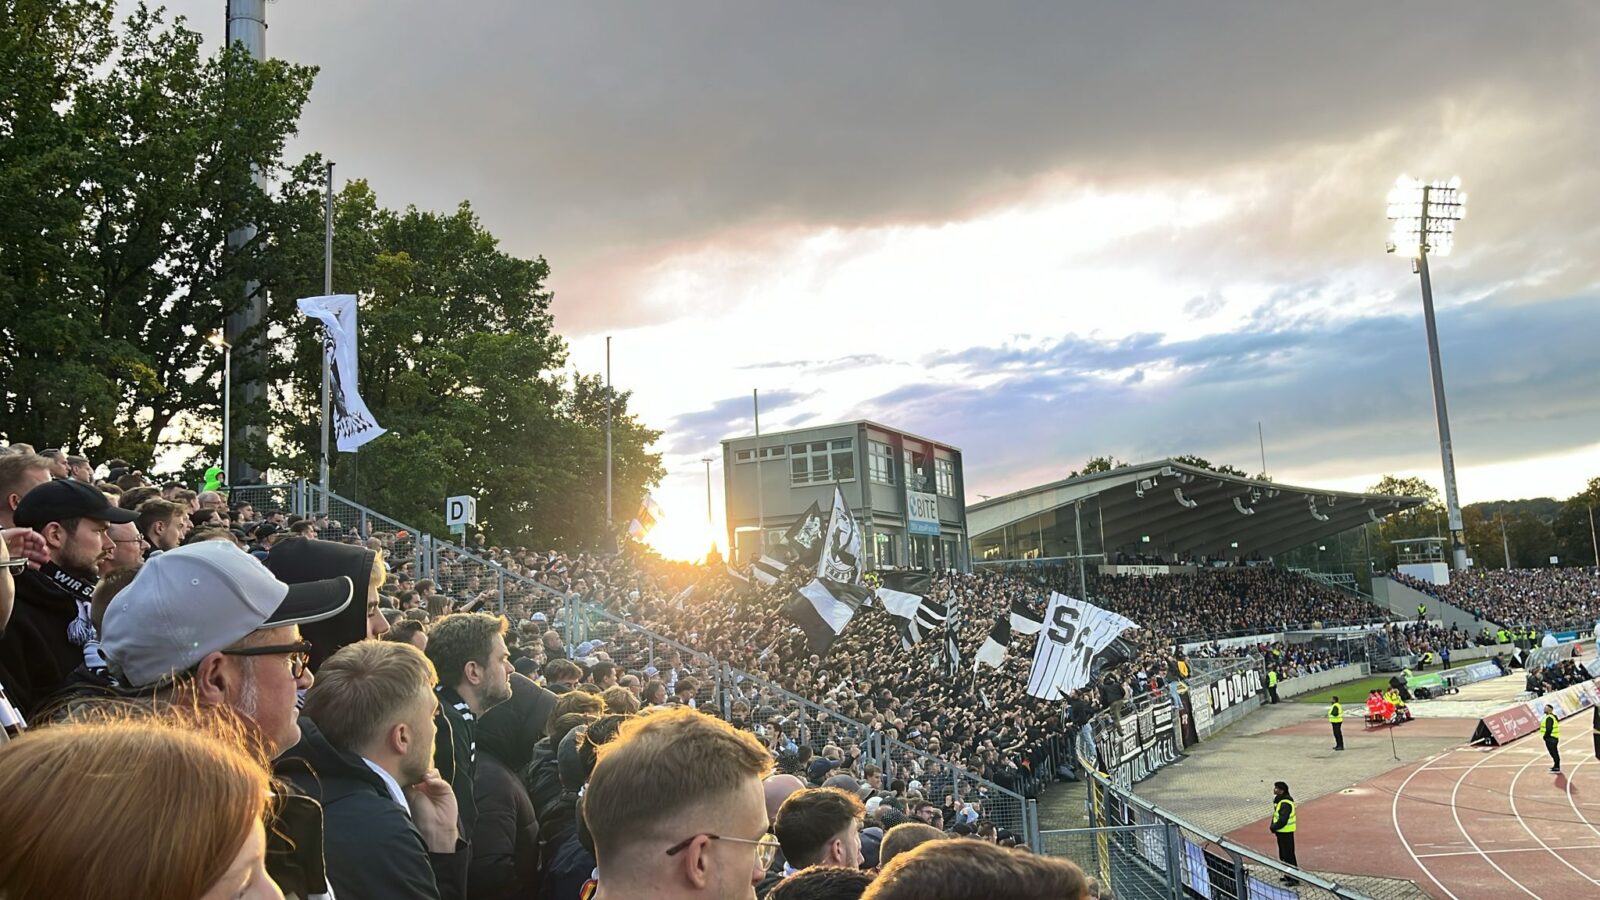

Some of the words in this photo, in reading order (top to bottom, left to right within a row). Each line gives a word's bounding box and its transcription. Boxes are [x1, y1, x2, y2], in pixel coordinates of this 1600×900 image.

[451, 501, 464, 521] D
[917, 498, 936, 519] BITE
[54, 570, 83, 590] WIR
[82, 584, 96, 598] S
[1212, 670, 1263, 710] D-BLOCK
